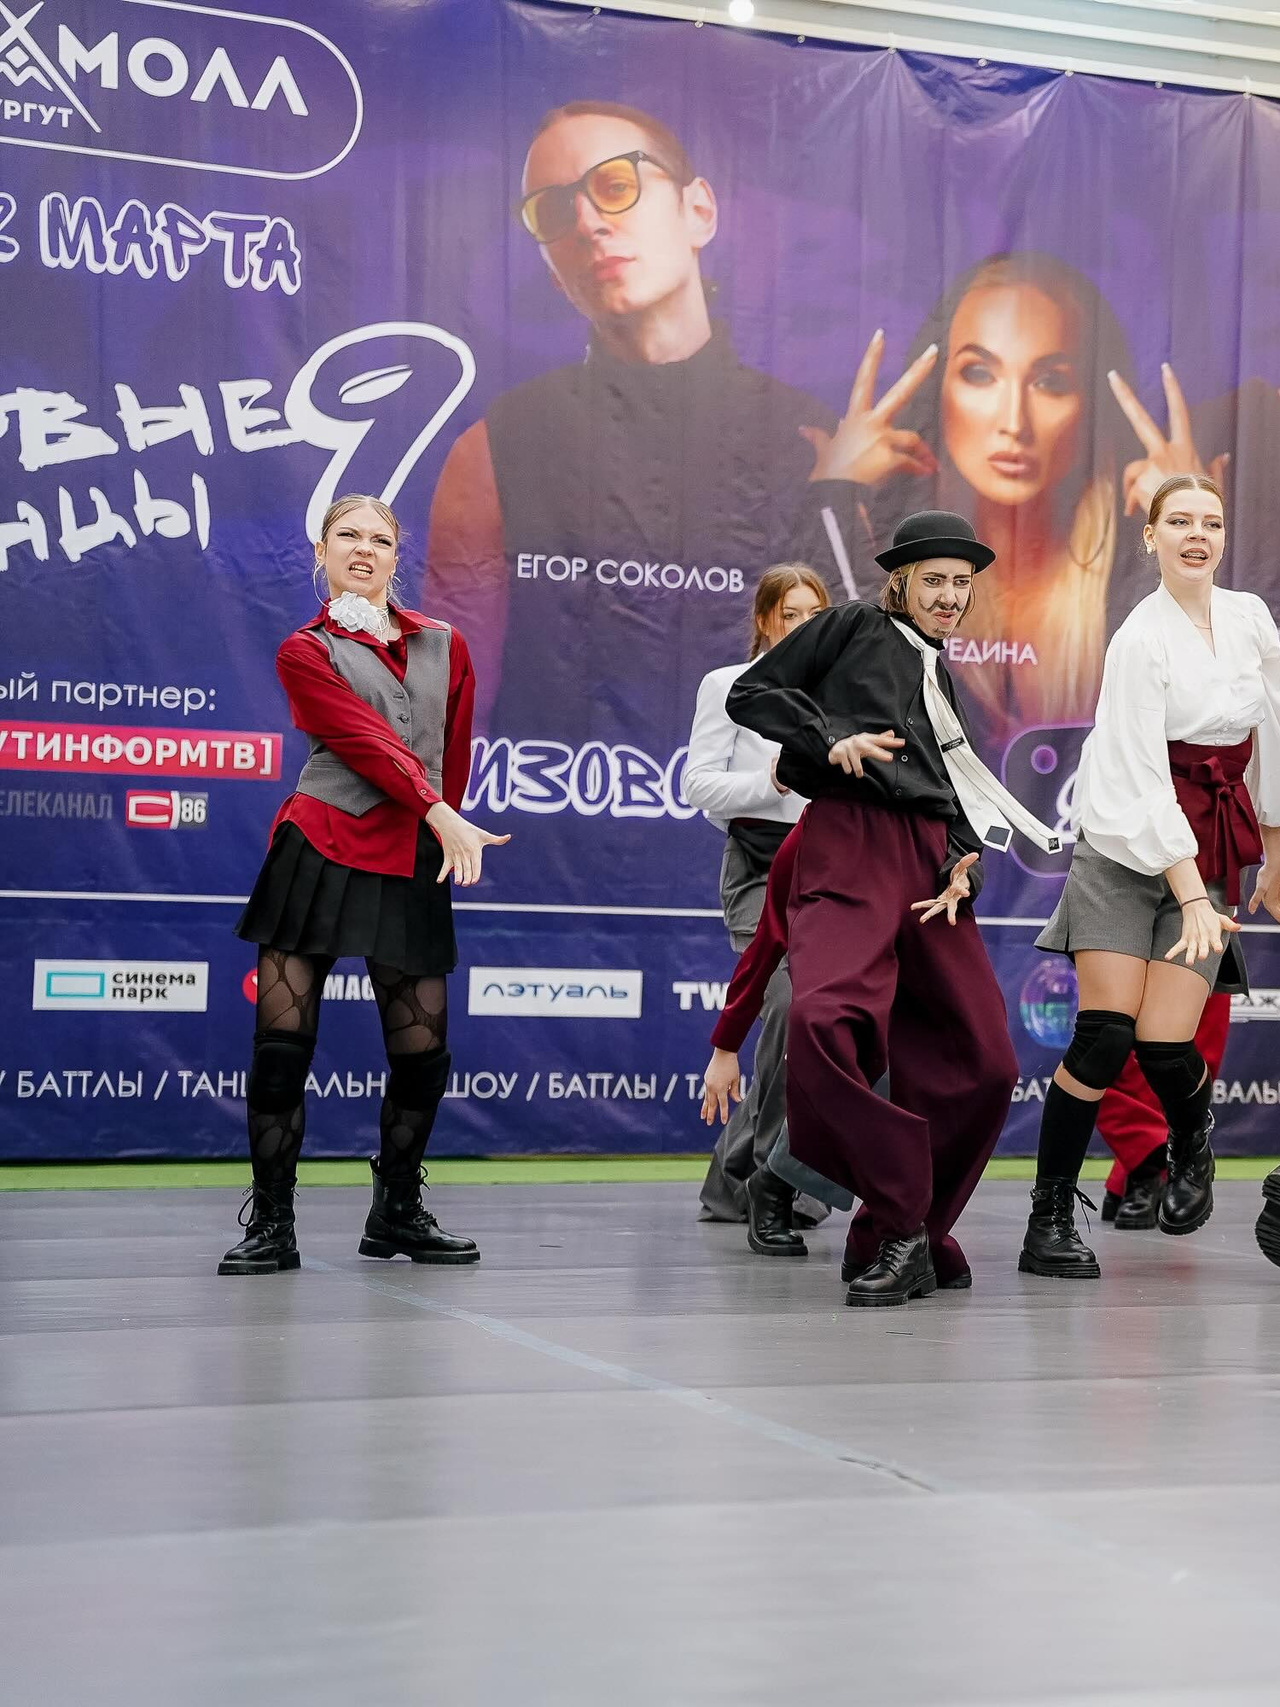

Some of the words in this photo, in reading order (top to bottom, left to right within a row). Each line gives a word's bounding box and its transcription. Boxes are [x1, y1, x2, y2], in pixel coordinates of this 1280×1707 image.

[58, 23, 309, 117] МОЛЛ
[0, 98, 74, 128] РГУТ
[38, 190, 302, 297] МАРТА
[0, 379, 304, 473] ВЫЕ
[517, 553, 589, 581] ЕГОР
[595, 558, 746, 593] СОКОЛОВ
[51, 679, 217, 716] партнер:
[112, 972, 197, 986] синема
[112, 986, 168, 1005] парк
[17, 1070, 142, 1098] БАТТЛЫ
[549, 1072, 657, 1100] БАТТЛЫ
